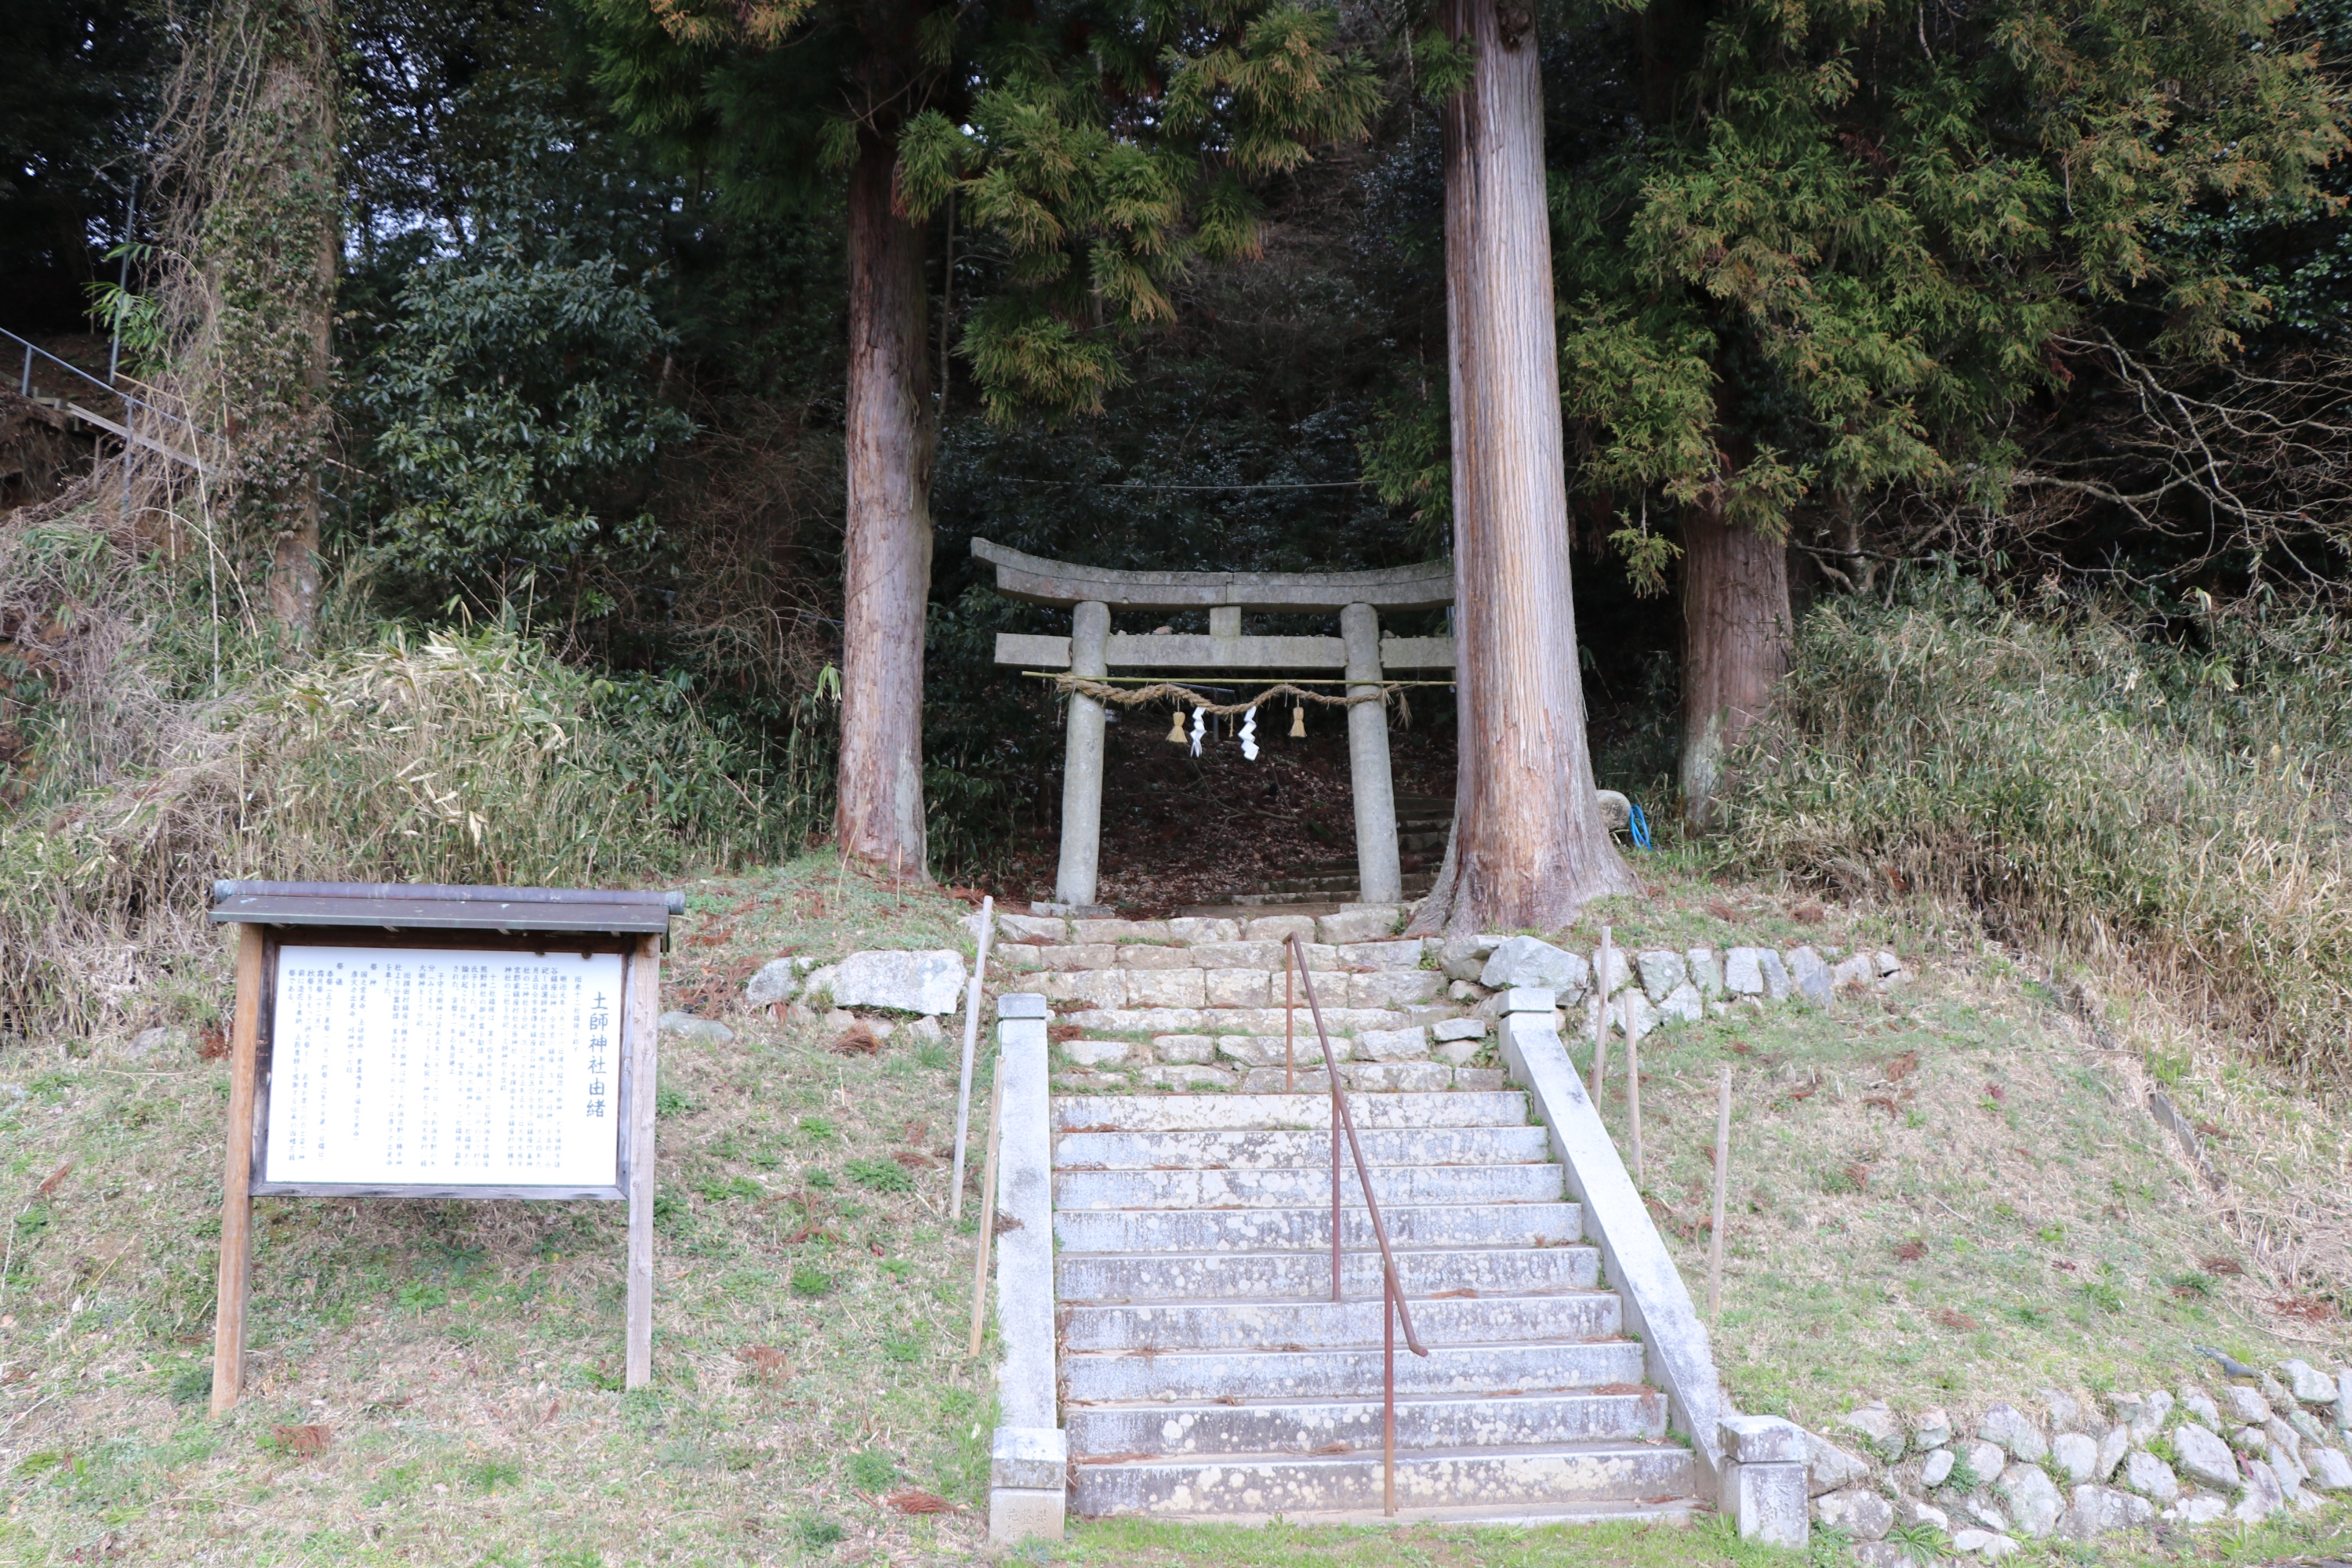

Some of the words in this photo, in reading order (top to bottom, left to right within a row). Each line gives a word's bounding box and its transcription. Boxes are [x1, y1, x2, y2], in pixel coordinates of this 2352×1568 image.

[288, 968, 296, 1003] 祭である。
[586, 991, 608, 1117] 土師神社由緒
